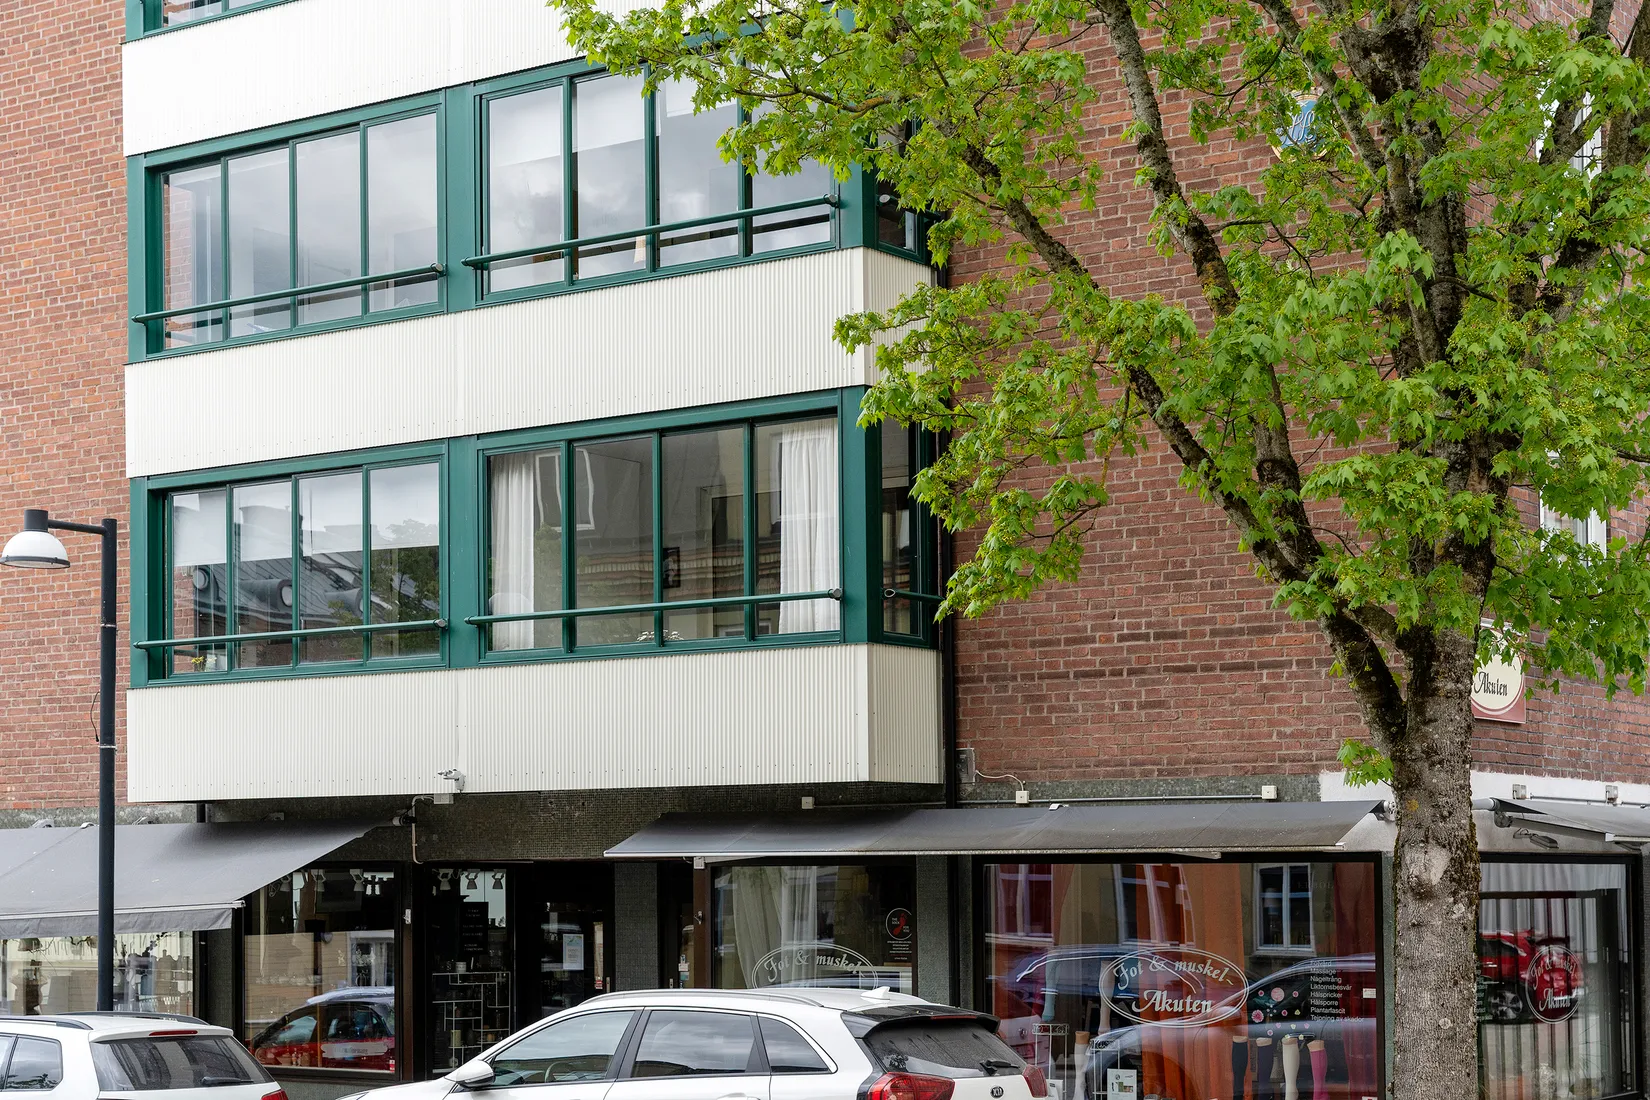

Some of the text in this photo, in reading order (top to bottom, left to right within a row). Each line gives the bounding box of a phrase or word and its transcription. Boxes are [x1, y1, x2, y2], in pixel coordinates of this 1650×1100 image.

[1474, 671, 1508, 697] Akuten
[795, 949, 810, 966] &
[1113, 959, 1144, 991] Fot
[1148, 955, 1167, 972] &
[1310, 975, 1342, 984] Nageltrång
[1131, 989, 1213, 1013] Akuten
